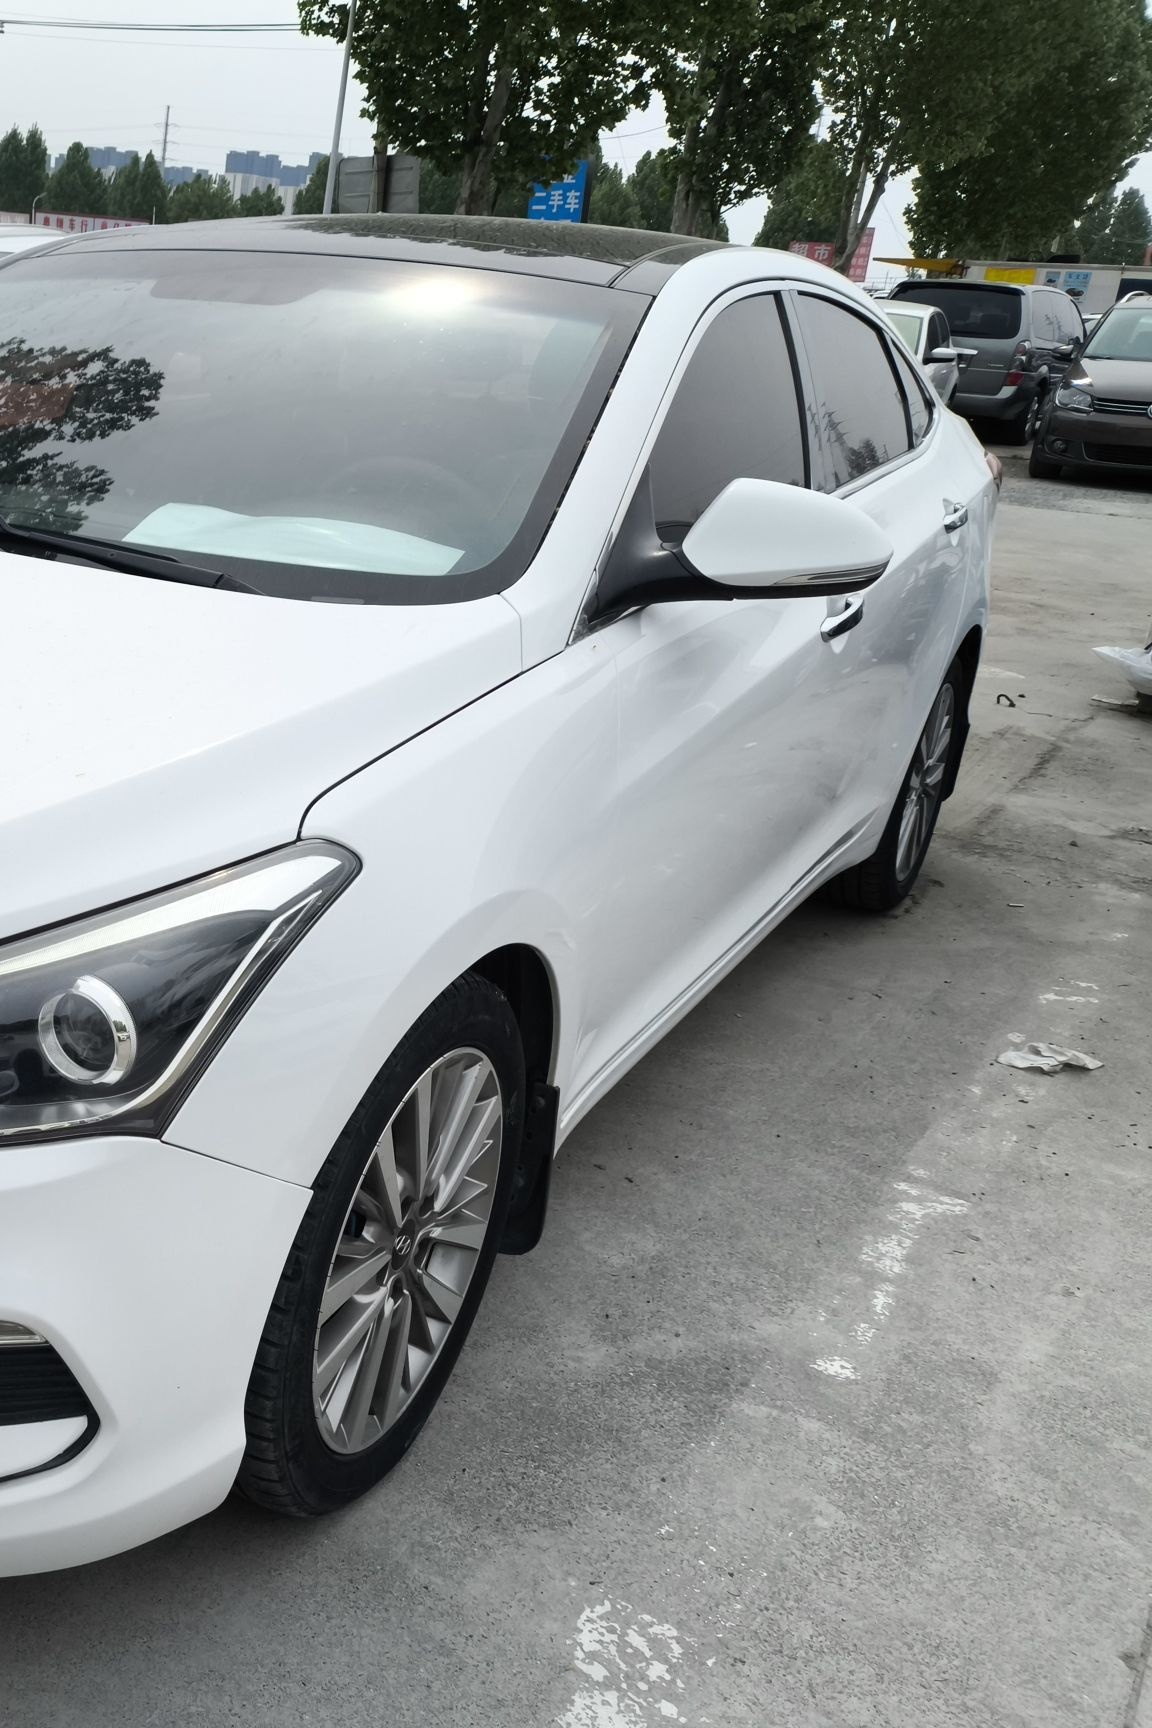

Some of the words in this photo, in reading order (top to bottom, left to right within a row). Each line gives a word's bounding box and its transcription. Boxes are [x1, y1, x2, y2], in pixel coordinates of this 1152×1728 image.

[531, 189, 581, 213] 二手车
[791, 242, 832, 260] 超市
